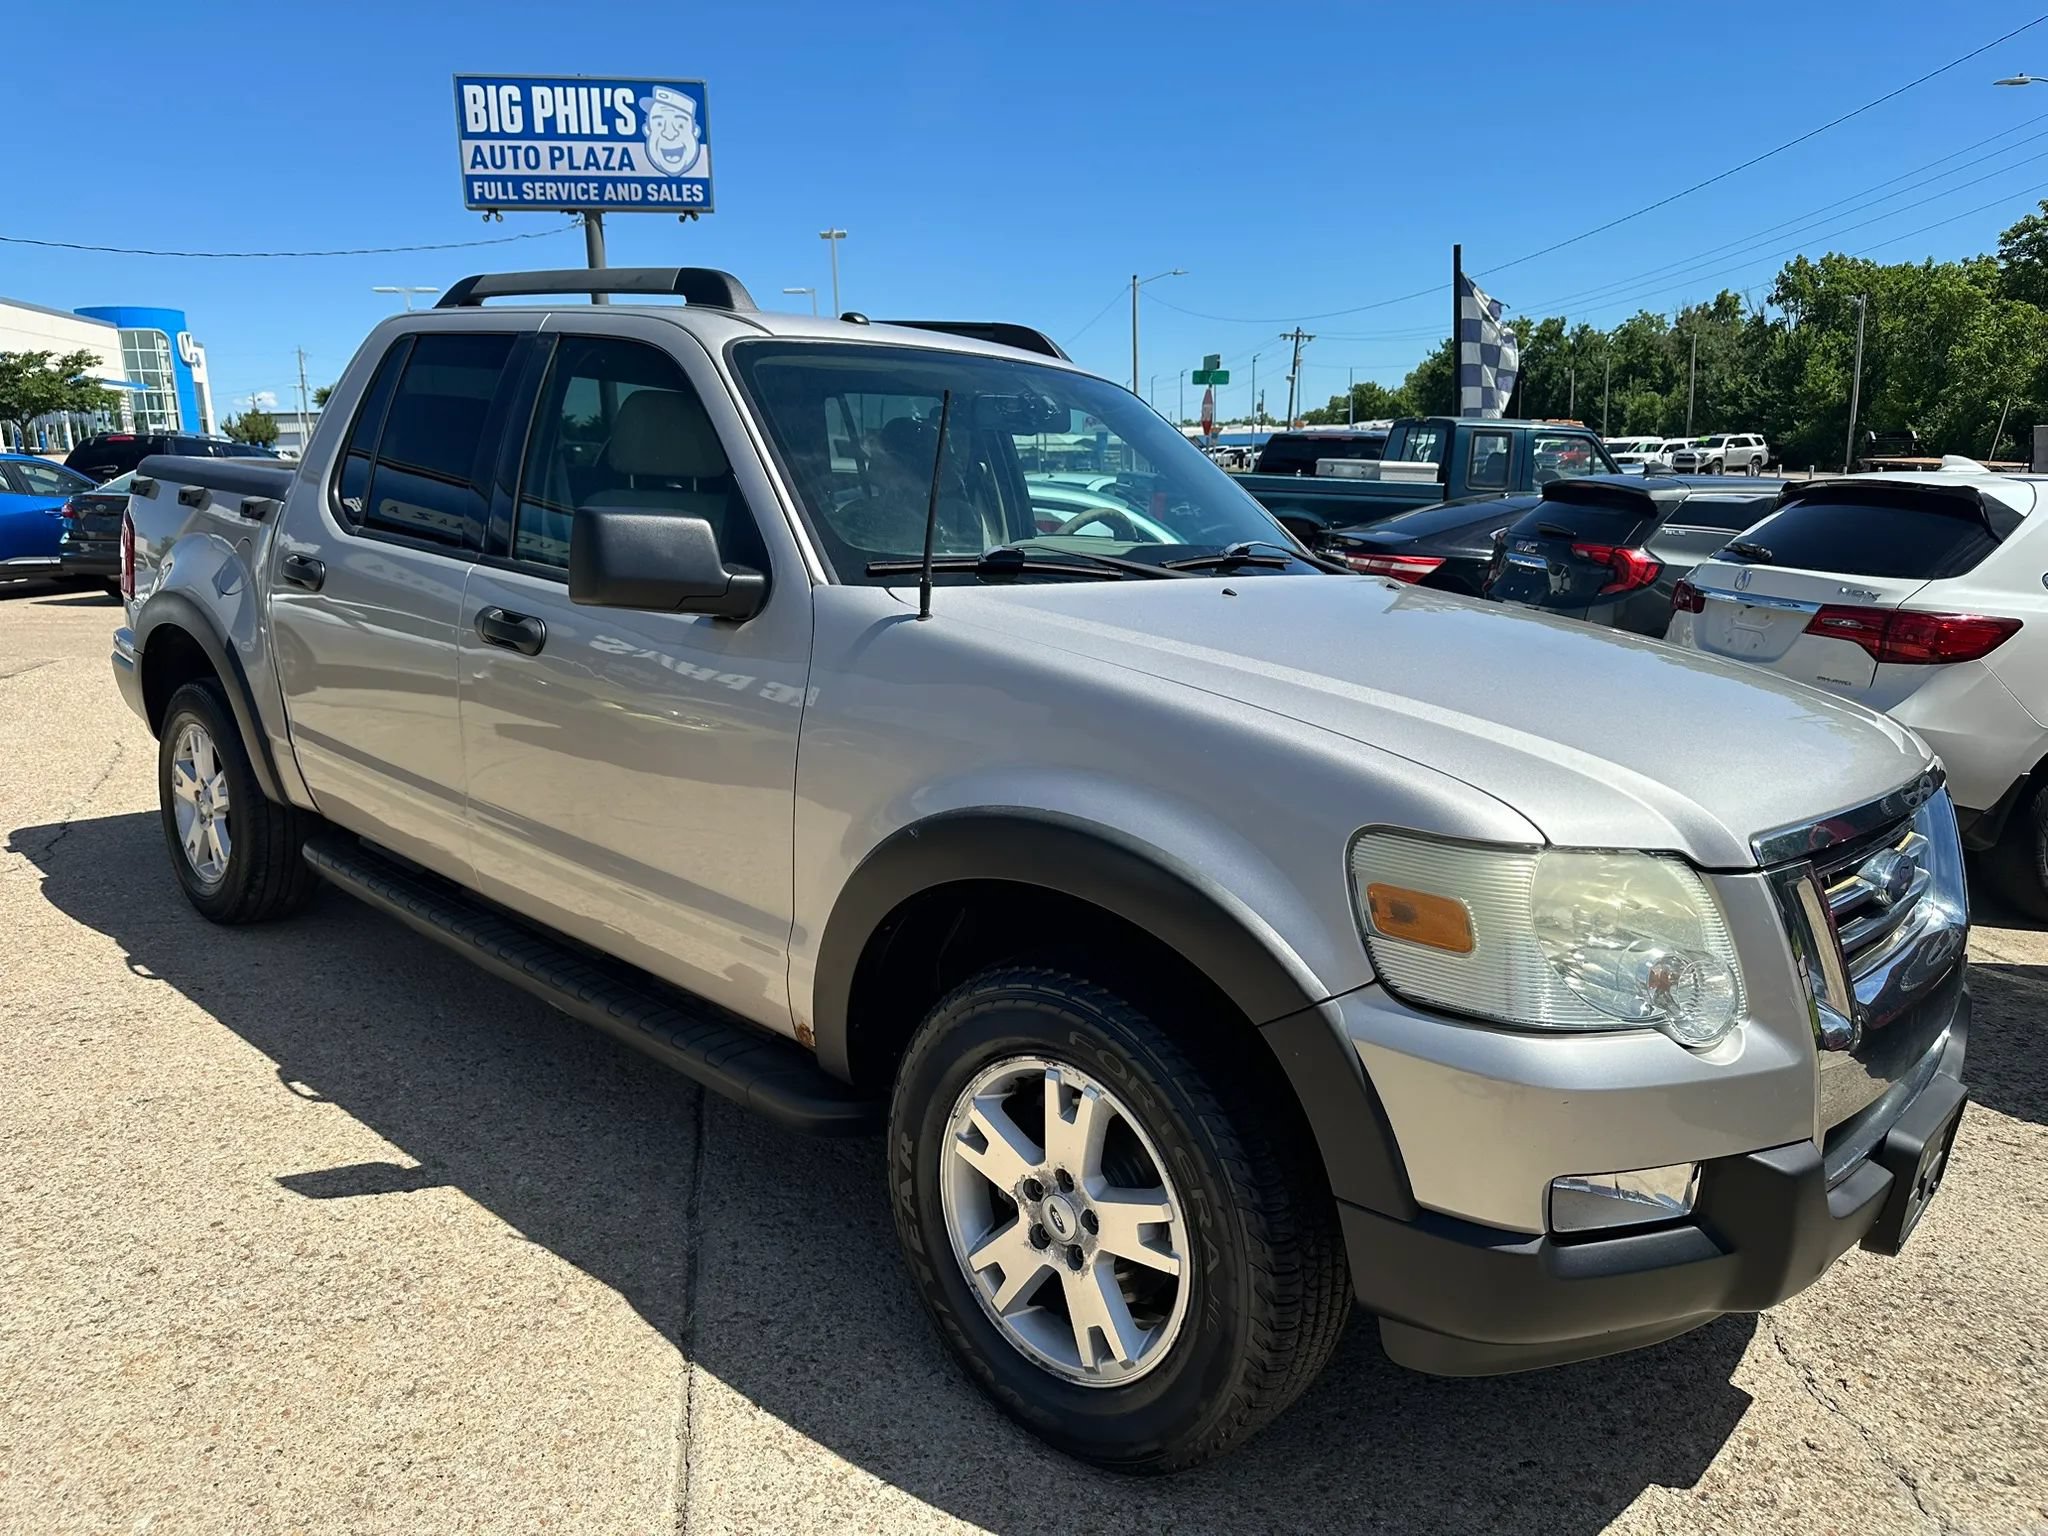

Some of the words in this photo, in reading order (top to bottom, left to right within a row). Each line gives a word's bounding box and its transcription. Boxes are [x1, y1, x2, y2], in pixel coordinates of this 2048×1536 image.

[463, 84, 523, 134] BIG
[531, 86, 637, 136] PHIL'S
[470, 145, 541, 170] AUTO
[548, 146, 636, 172] PLAZA
[473, 181, 518, 200] FULL
[522, 182, 599, 201] SERVICE
[604, 183, 642, 202] AND
[647, 184, 704, 203] SALES
